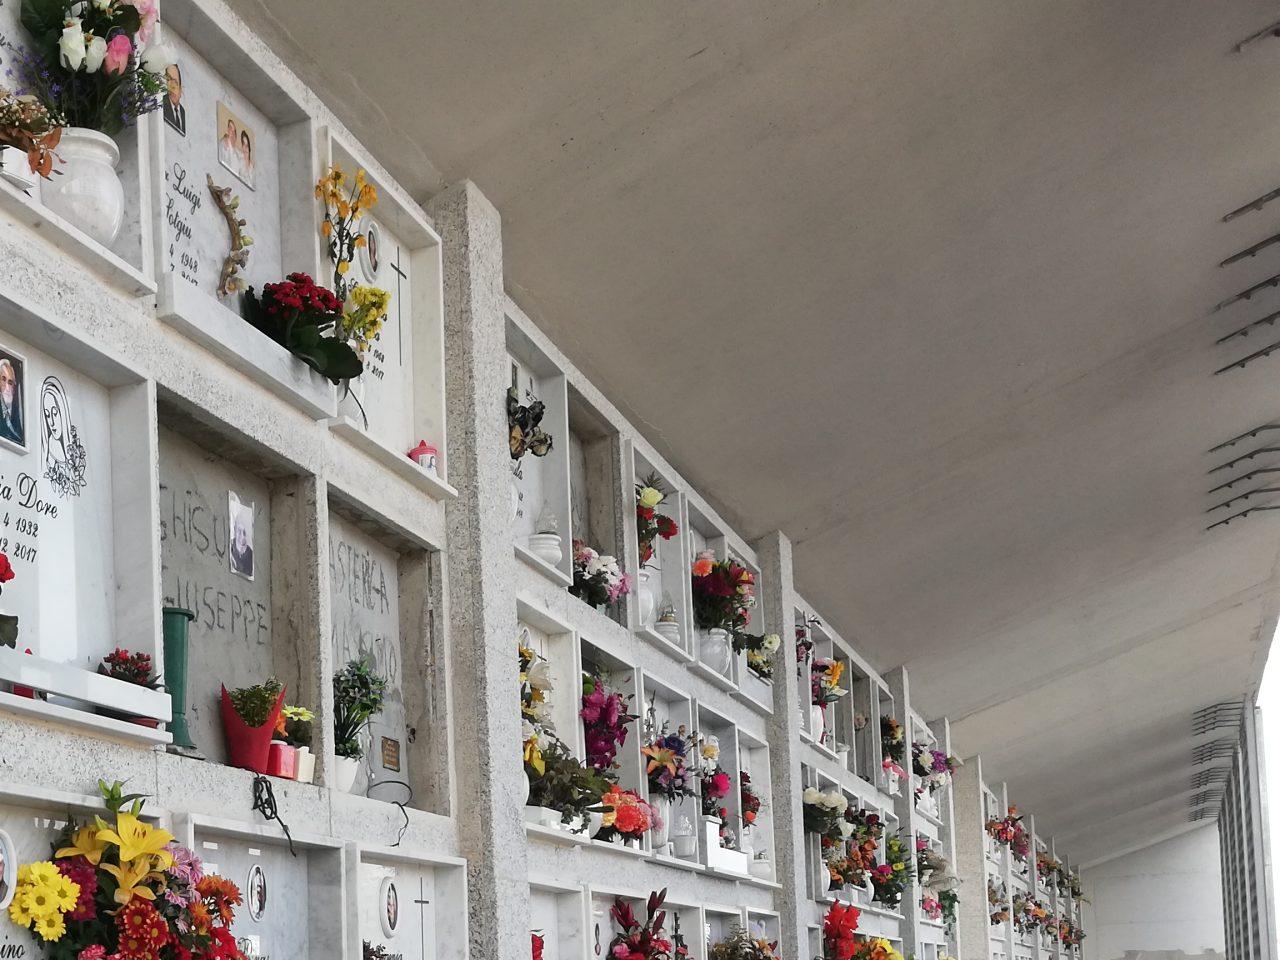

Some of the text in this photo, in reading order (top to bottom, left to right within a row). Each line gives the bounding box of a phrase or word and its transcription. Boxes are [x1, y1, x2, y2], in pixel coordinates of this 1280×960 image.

[173, 163, 202, 215] Luigi
[181, 252, 199, 274] 1948
[16, 472, 58, 519] Dore
[3, 512, 10, 527] 4
[15, 517, 39, 538] 1932
[13, 542, 38, 563] 2017
